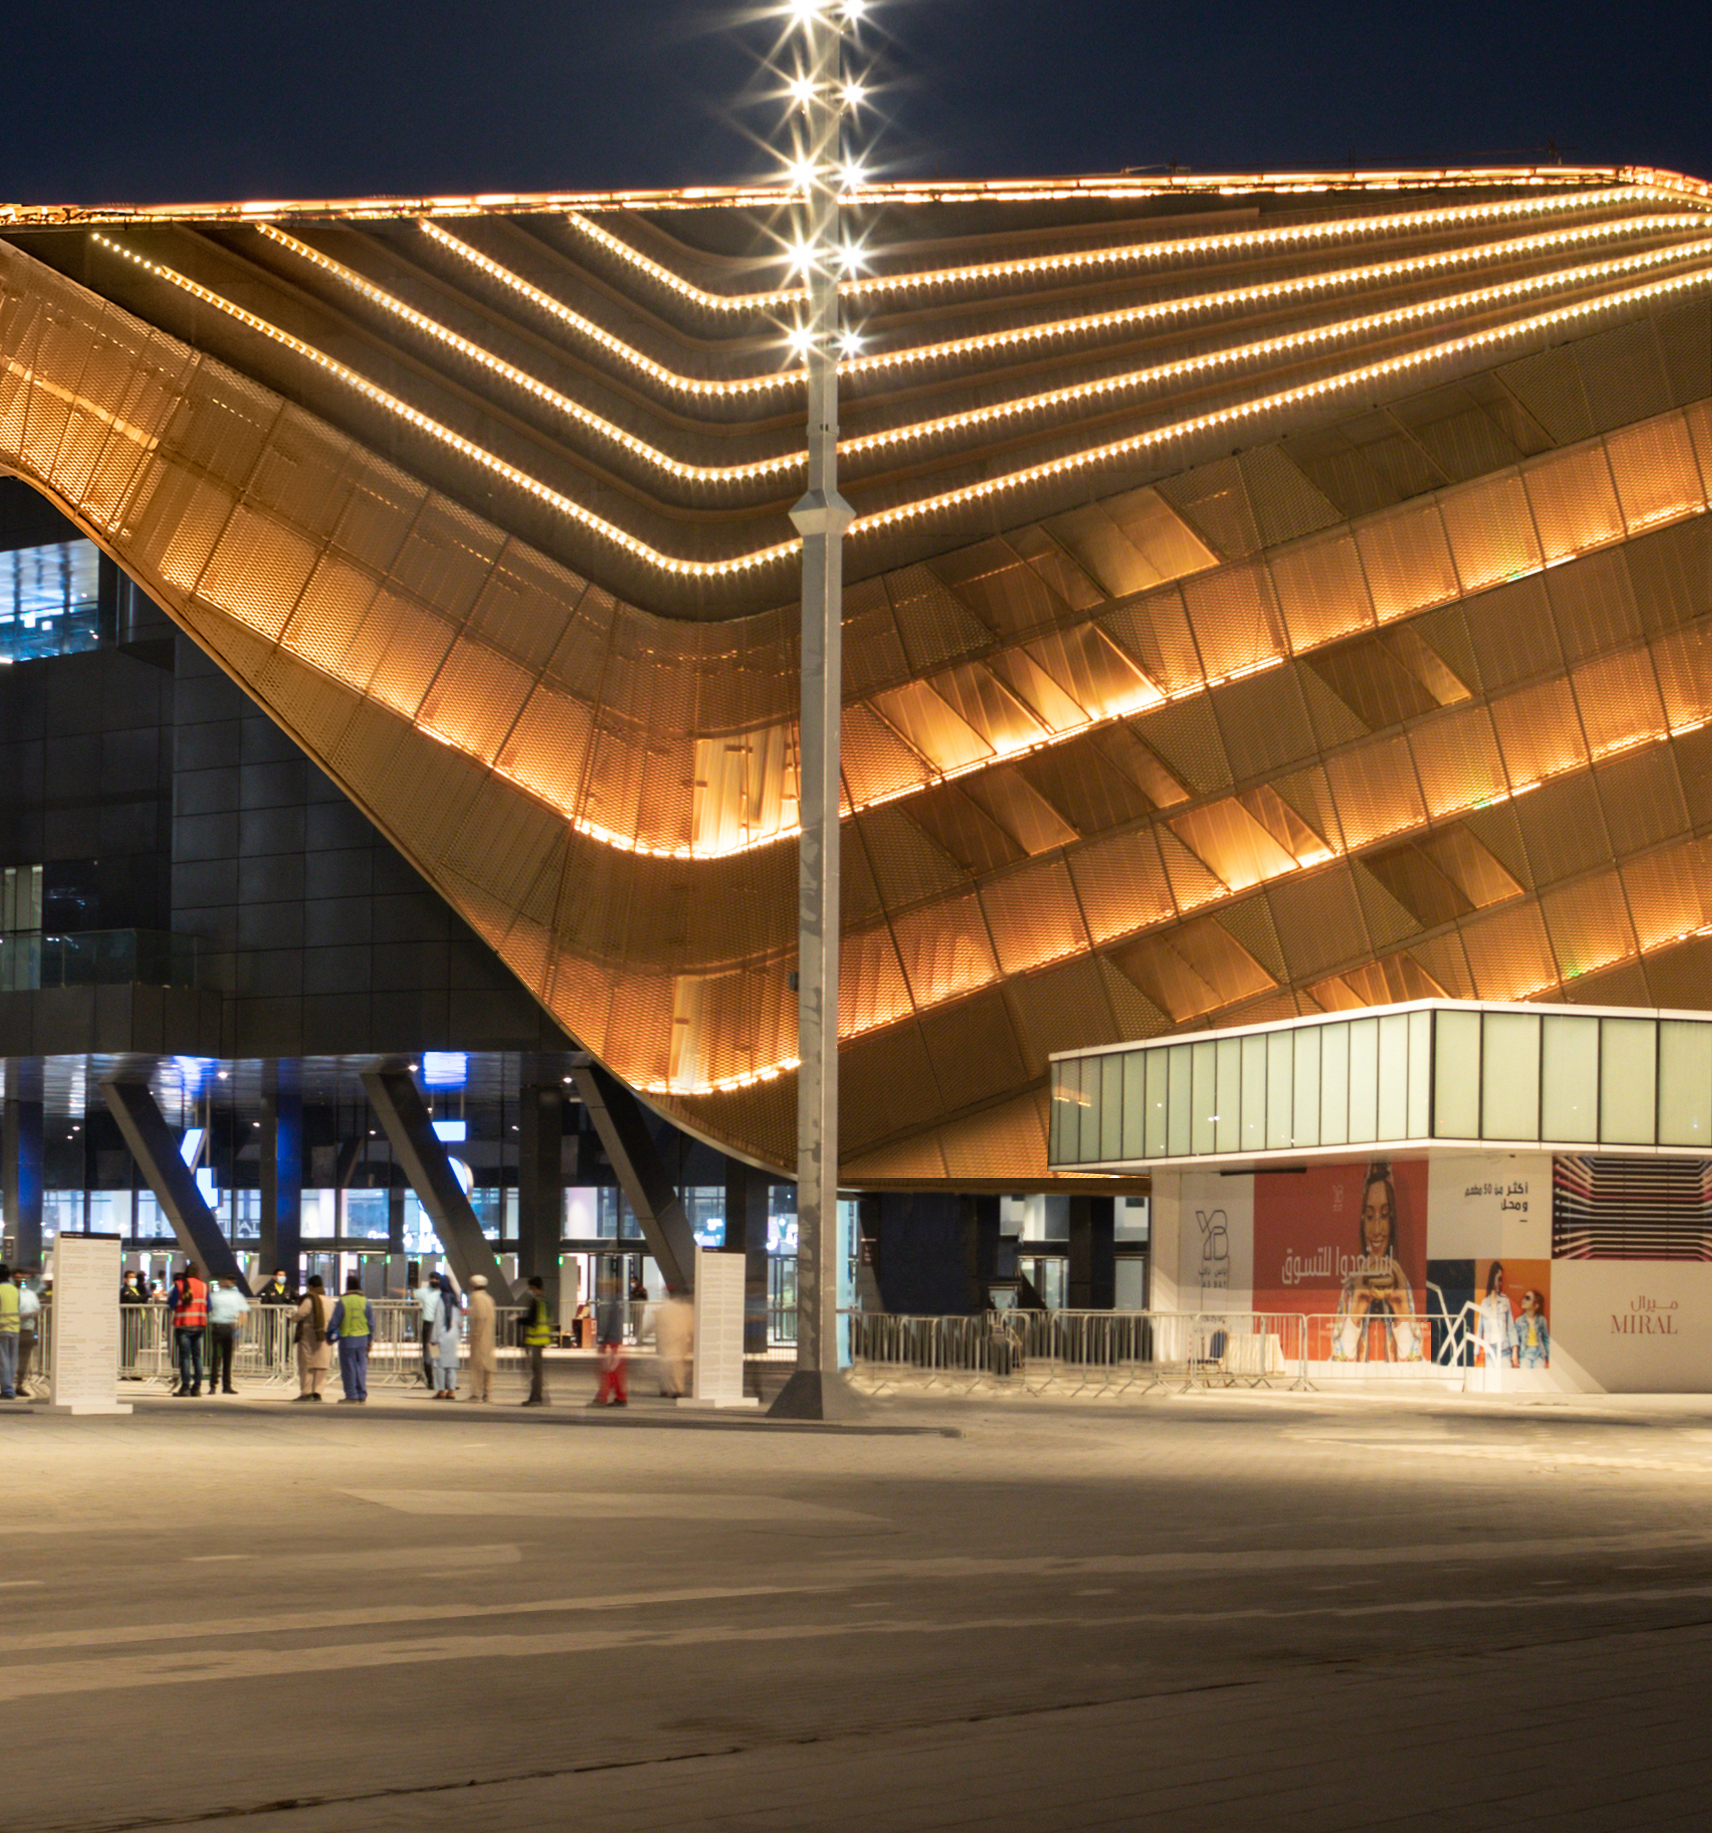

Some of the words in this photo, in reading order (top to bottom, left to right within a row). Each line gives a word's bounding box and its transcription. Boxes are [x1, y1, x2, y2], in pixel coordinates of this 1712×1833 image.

[1281, 1246, 1331, 1284] للتسوق
[1335, 1245, 1394, 1284] استعدوا
[1630, 1295, 1679, 1312] ميرال
[1610, 1314, 1678, 1334] MIRAL
